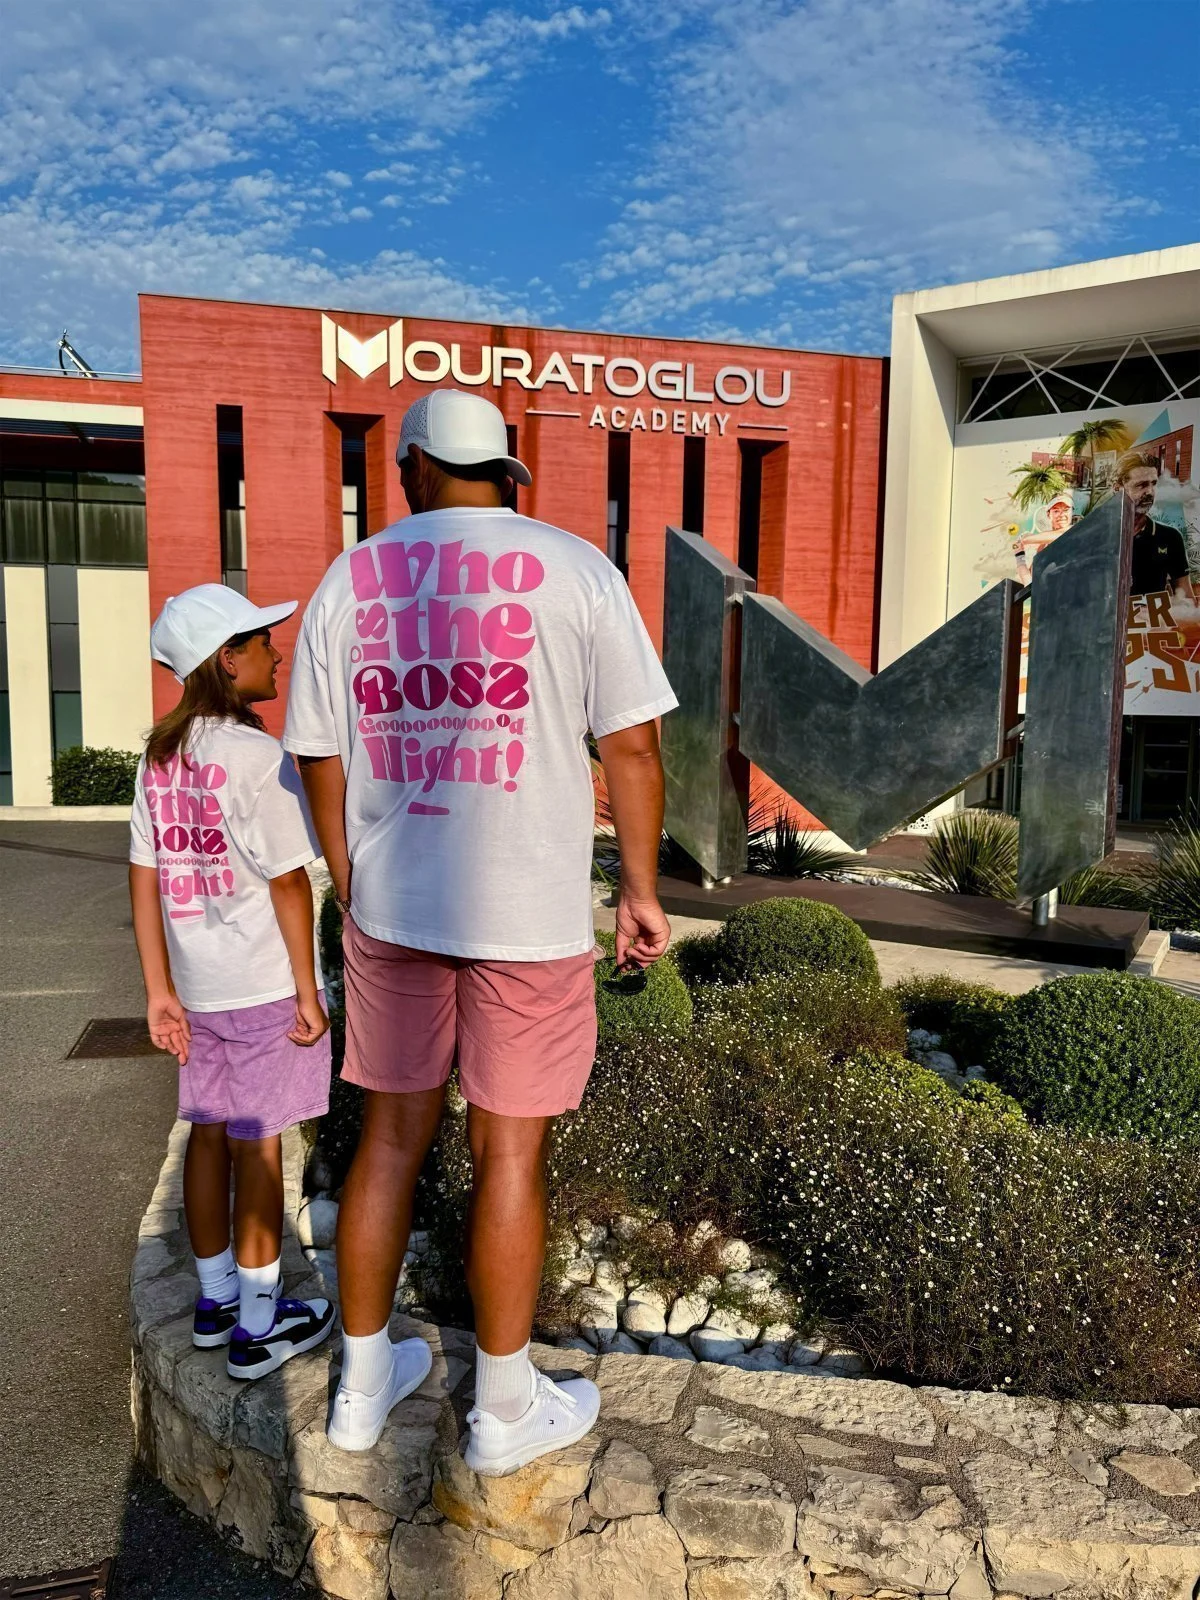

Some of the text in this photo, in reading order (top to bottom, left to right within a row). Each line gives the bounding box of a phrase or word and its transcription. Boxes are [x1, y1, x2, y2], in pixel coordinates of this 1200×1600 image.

[321, 312, 791, 407] MOURATOGLOU
[589, 404, 730, 436] ACADEMY
[350, 539, 544, 602] Who
[391, 598, 536, 662] the
[362, 734, 525, 793] Night!
[160, 790, 223, 827] the
[160, 868, 235, 905] ight!
